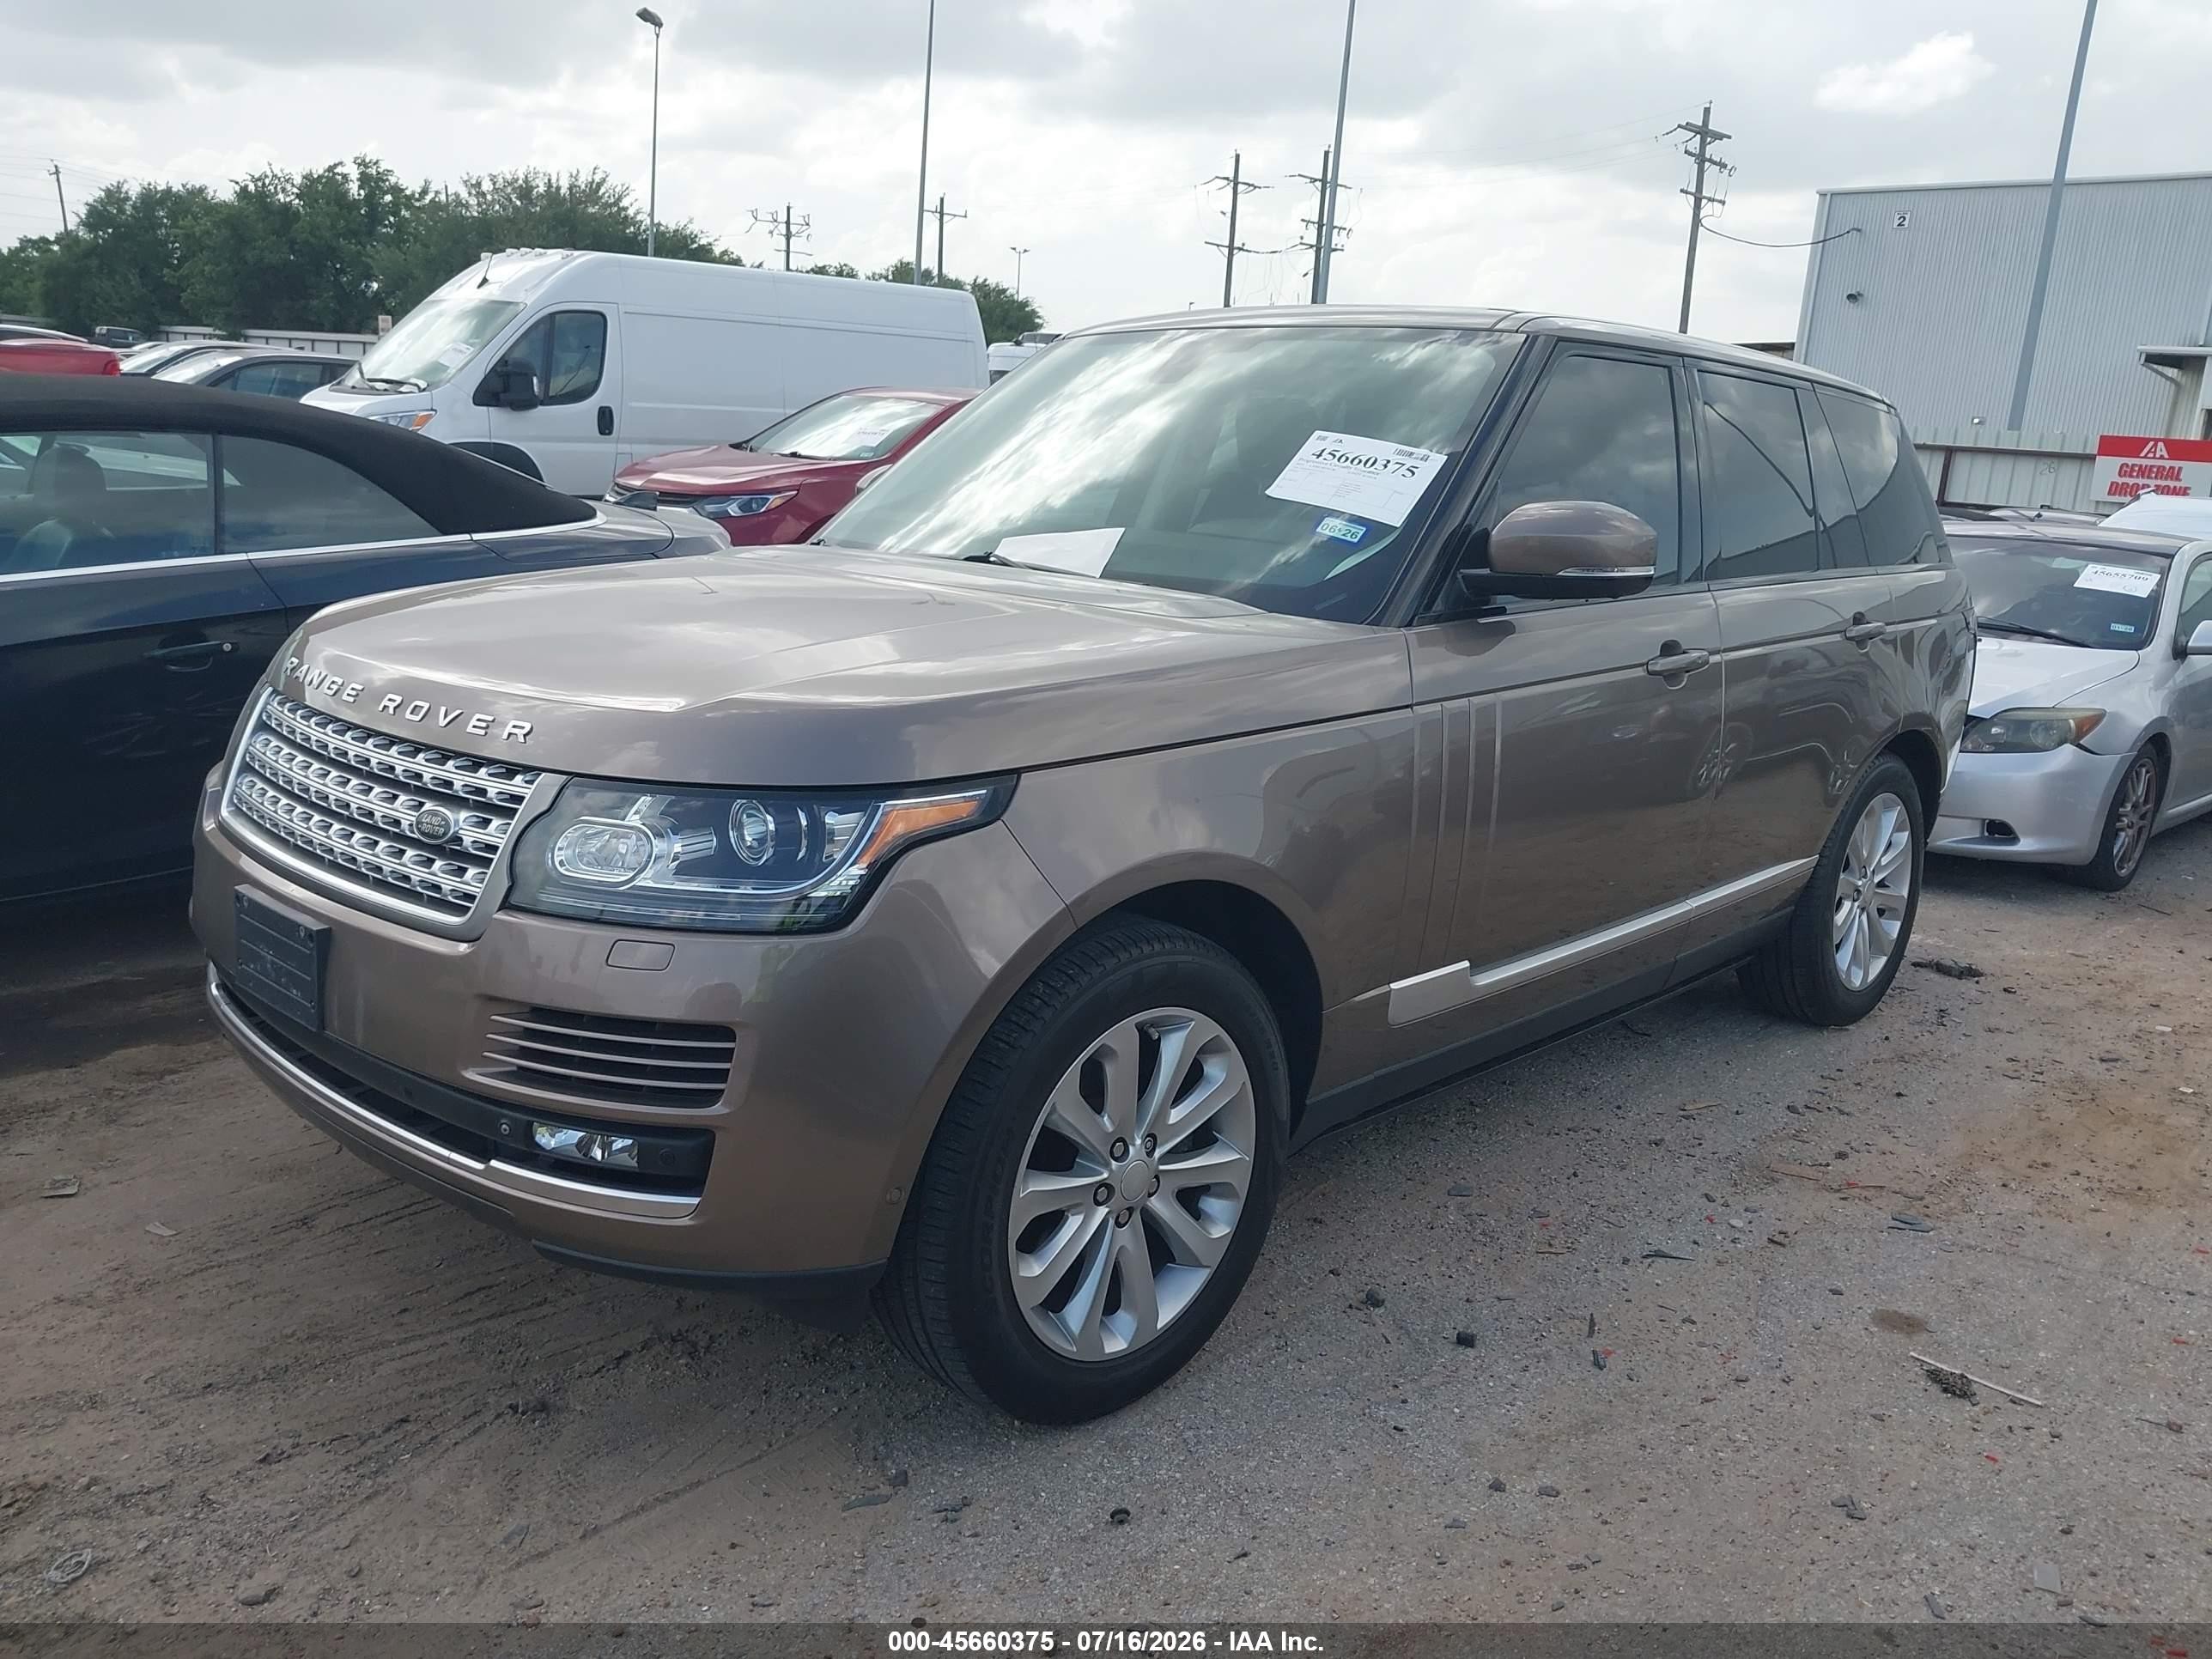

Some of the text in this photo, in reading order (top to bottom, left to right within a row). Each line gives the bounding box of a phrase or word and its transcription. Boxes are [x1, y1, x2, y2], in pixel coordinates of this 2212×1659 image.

[1897, 216, 1906, 227] 2
[1311, 447, 1420, 478] 45660375
[2118, 463, 2184, 482] GENERAL
[283, 656, 534, 744] RANGE ROVER
